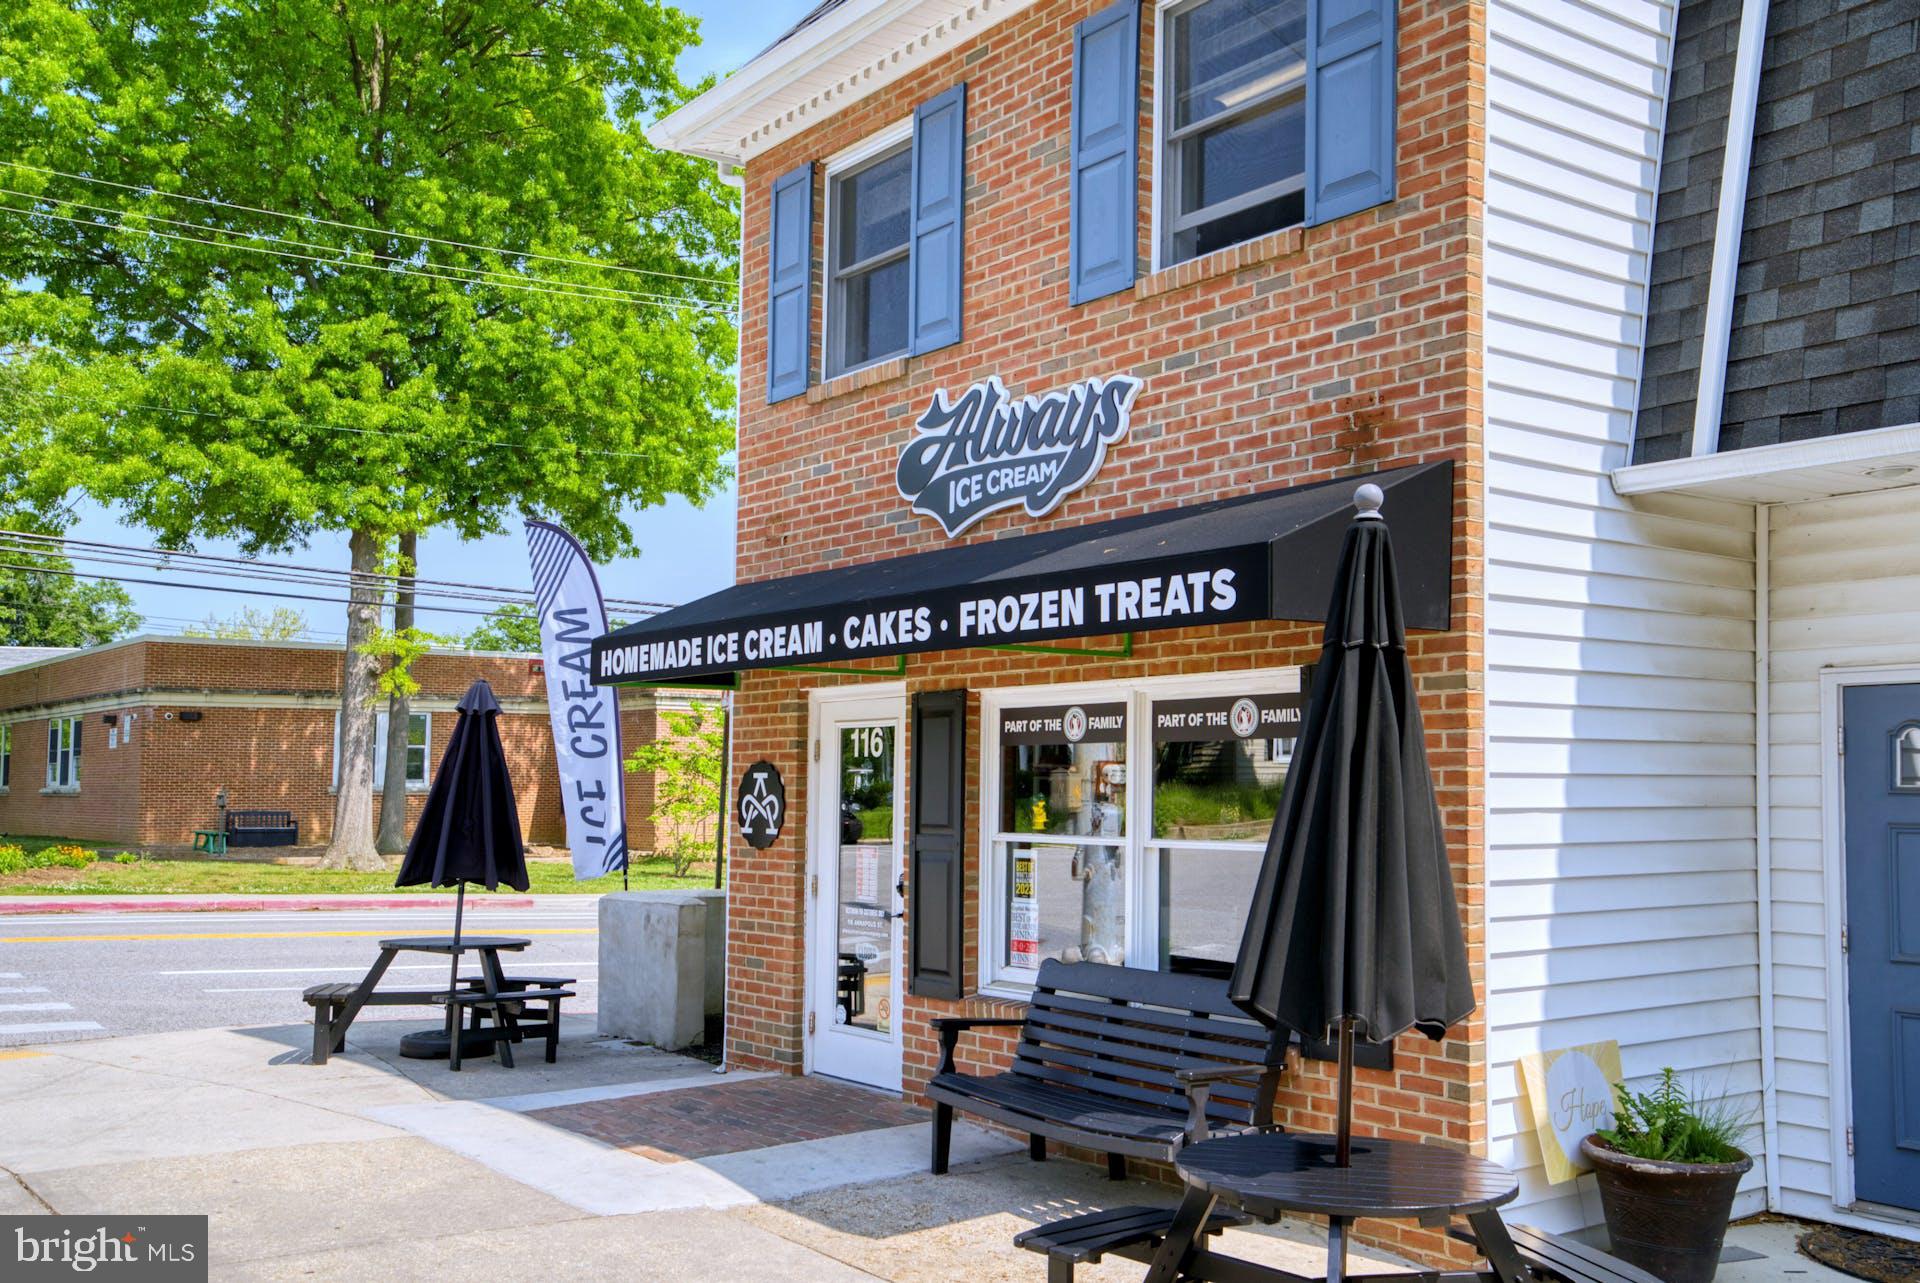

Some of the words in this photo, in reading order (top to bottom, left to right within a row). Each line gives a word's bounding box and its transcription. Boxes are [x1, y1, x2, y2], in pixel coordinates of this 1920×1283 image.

[897, 378, 1134, 498] Always
[949, 474, 983, 514] ICE
[986, 459, 1057, 495] CREAM
[600, 636, 702, 678] HOMEMADE
[706, 631, 739, 665] ICE
[744, 621, 823, 661] CREAM
[843, 606, 932, 650] CAKES
[959, 586, 1084, 638] FROZEN
[1094, 568, 1237, 623] TREATS
[1004, 719, 1028, 733] PART
[1029, 719, 1043, 732] OF
[1044, 718, 1062, 731] THE
[1088, 715, 1124, 730] FAMILY
[1158, 713, 1185, 728] PART
[1187, 713, 1204, 727] OF
[1205, 711, 1228, 726] THE
[851, 727, 884, 758] 116
[1015, 882, 1035, 896] 2023
